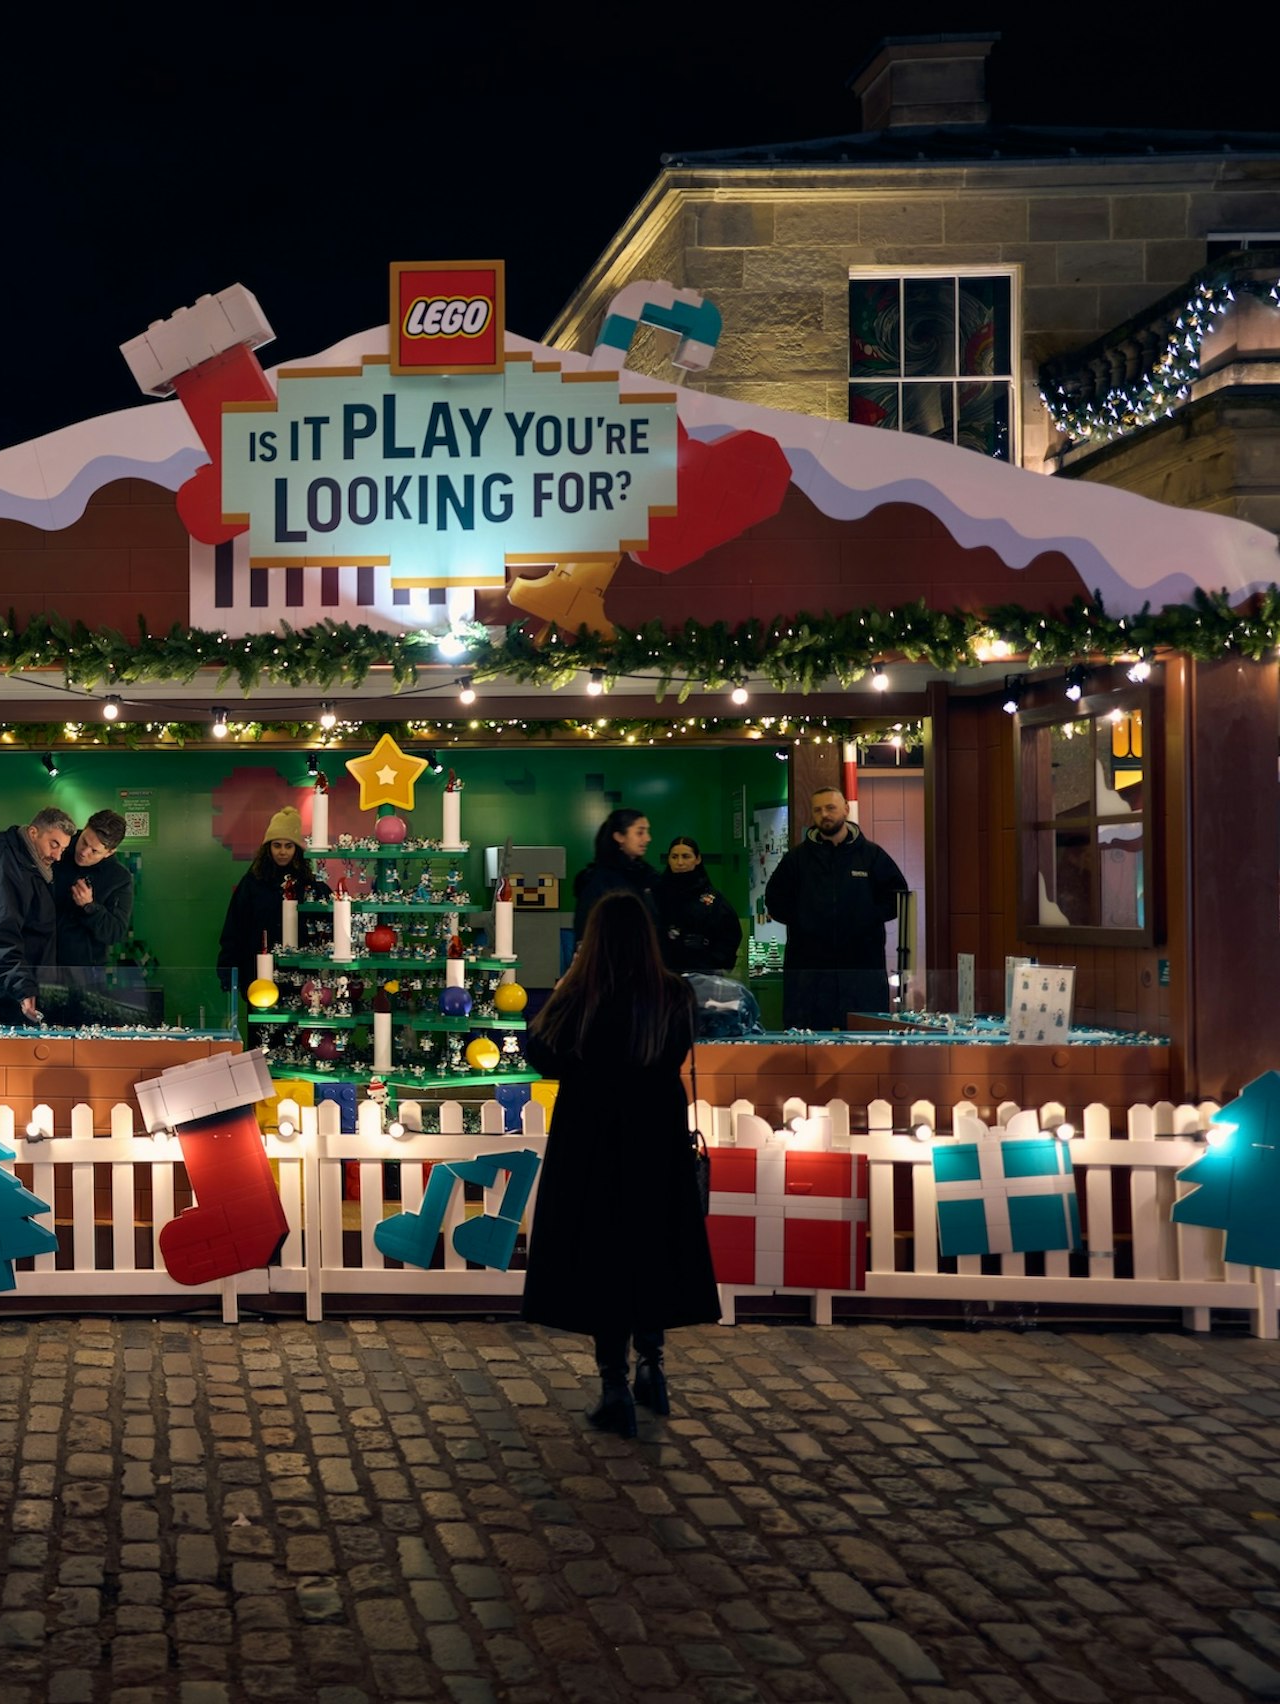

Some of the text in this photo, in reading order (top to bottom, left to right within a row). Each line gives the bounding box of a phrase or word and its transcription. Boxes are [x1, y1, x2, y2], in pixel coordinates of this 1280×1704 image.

[405, 298, 490, 337] LEGO
[249, 393, 650, 462] IS IT PLAY YOU'RE
[274, 470, 633, 543] LOOKING FOR?
